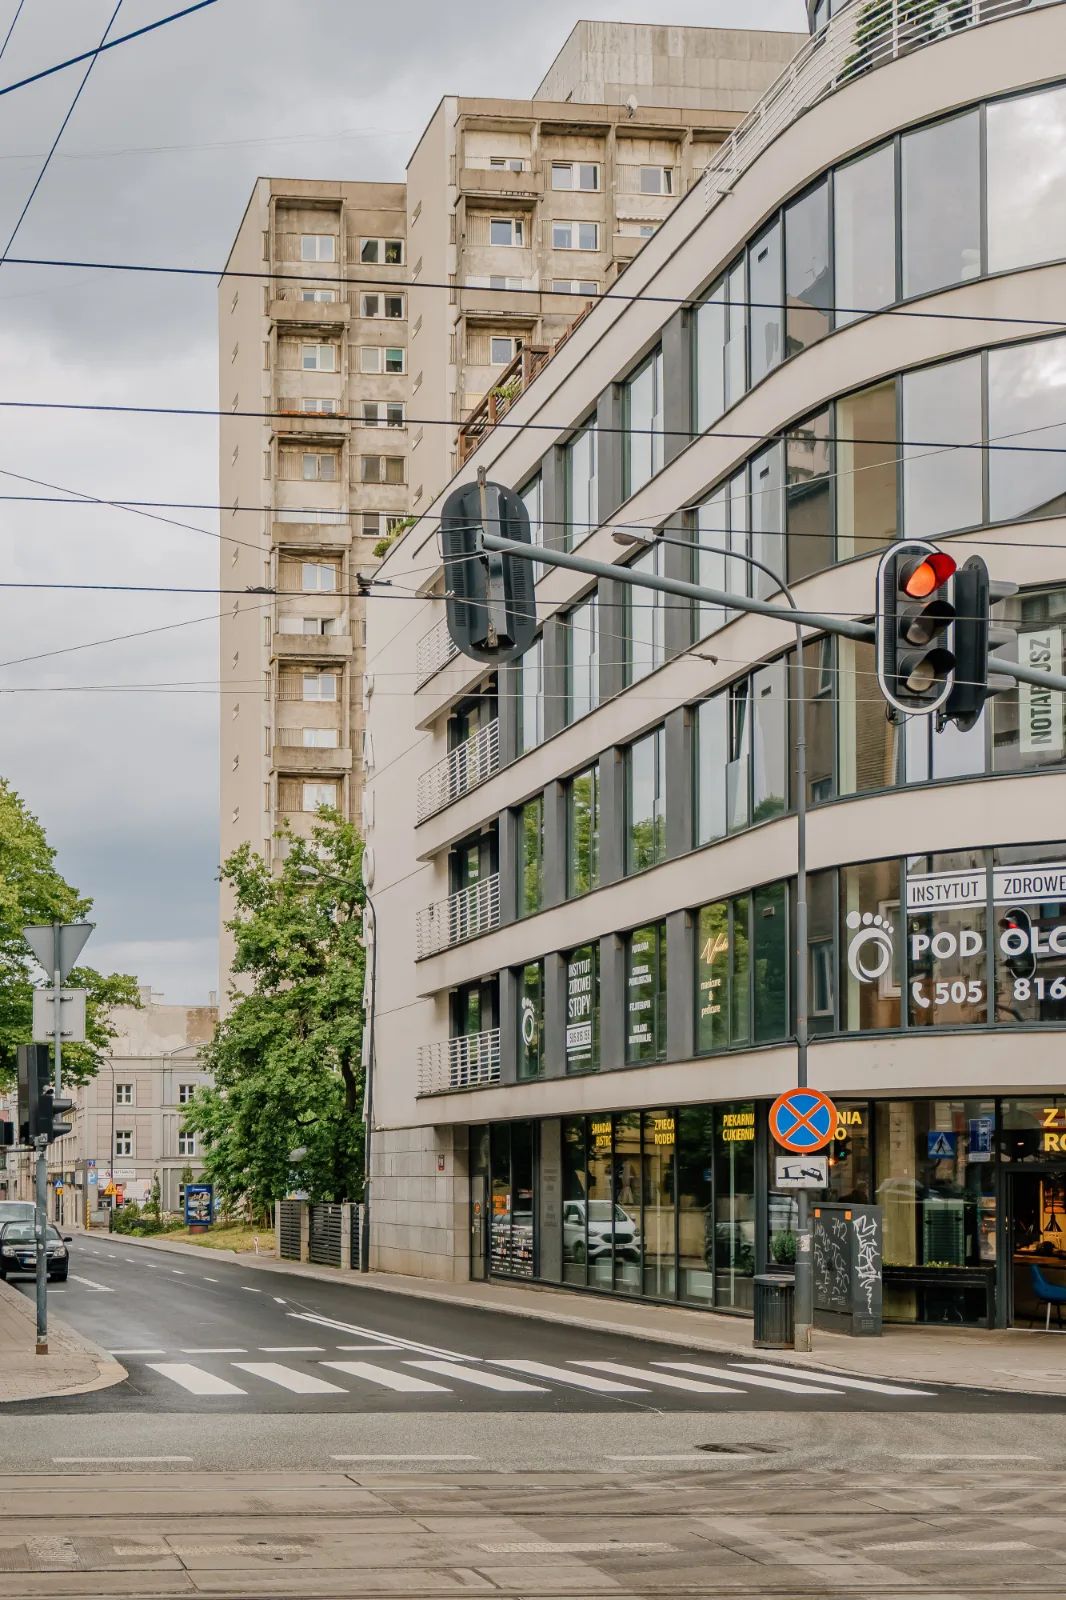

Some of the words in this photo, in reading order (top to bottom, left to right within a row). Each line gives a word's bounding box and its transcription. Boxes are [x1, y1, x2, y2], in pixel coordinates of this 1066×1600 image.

[1029, 637, 1052, 745] NOTARUSZ
[912, 881, 979, 902] INSTYTUT
[568, 959, 591, 977] INSTYTUT
[934, 980, 983, 1004] 505
[1014, 977, 1066, 1001] 816
[568, 994, 591, 1018] STOPY
[836, 1111, 862, 1125] NIA
[1043, 1108, 1059, 1127] Z
